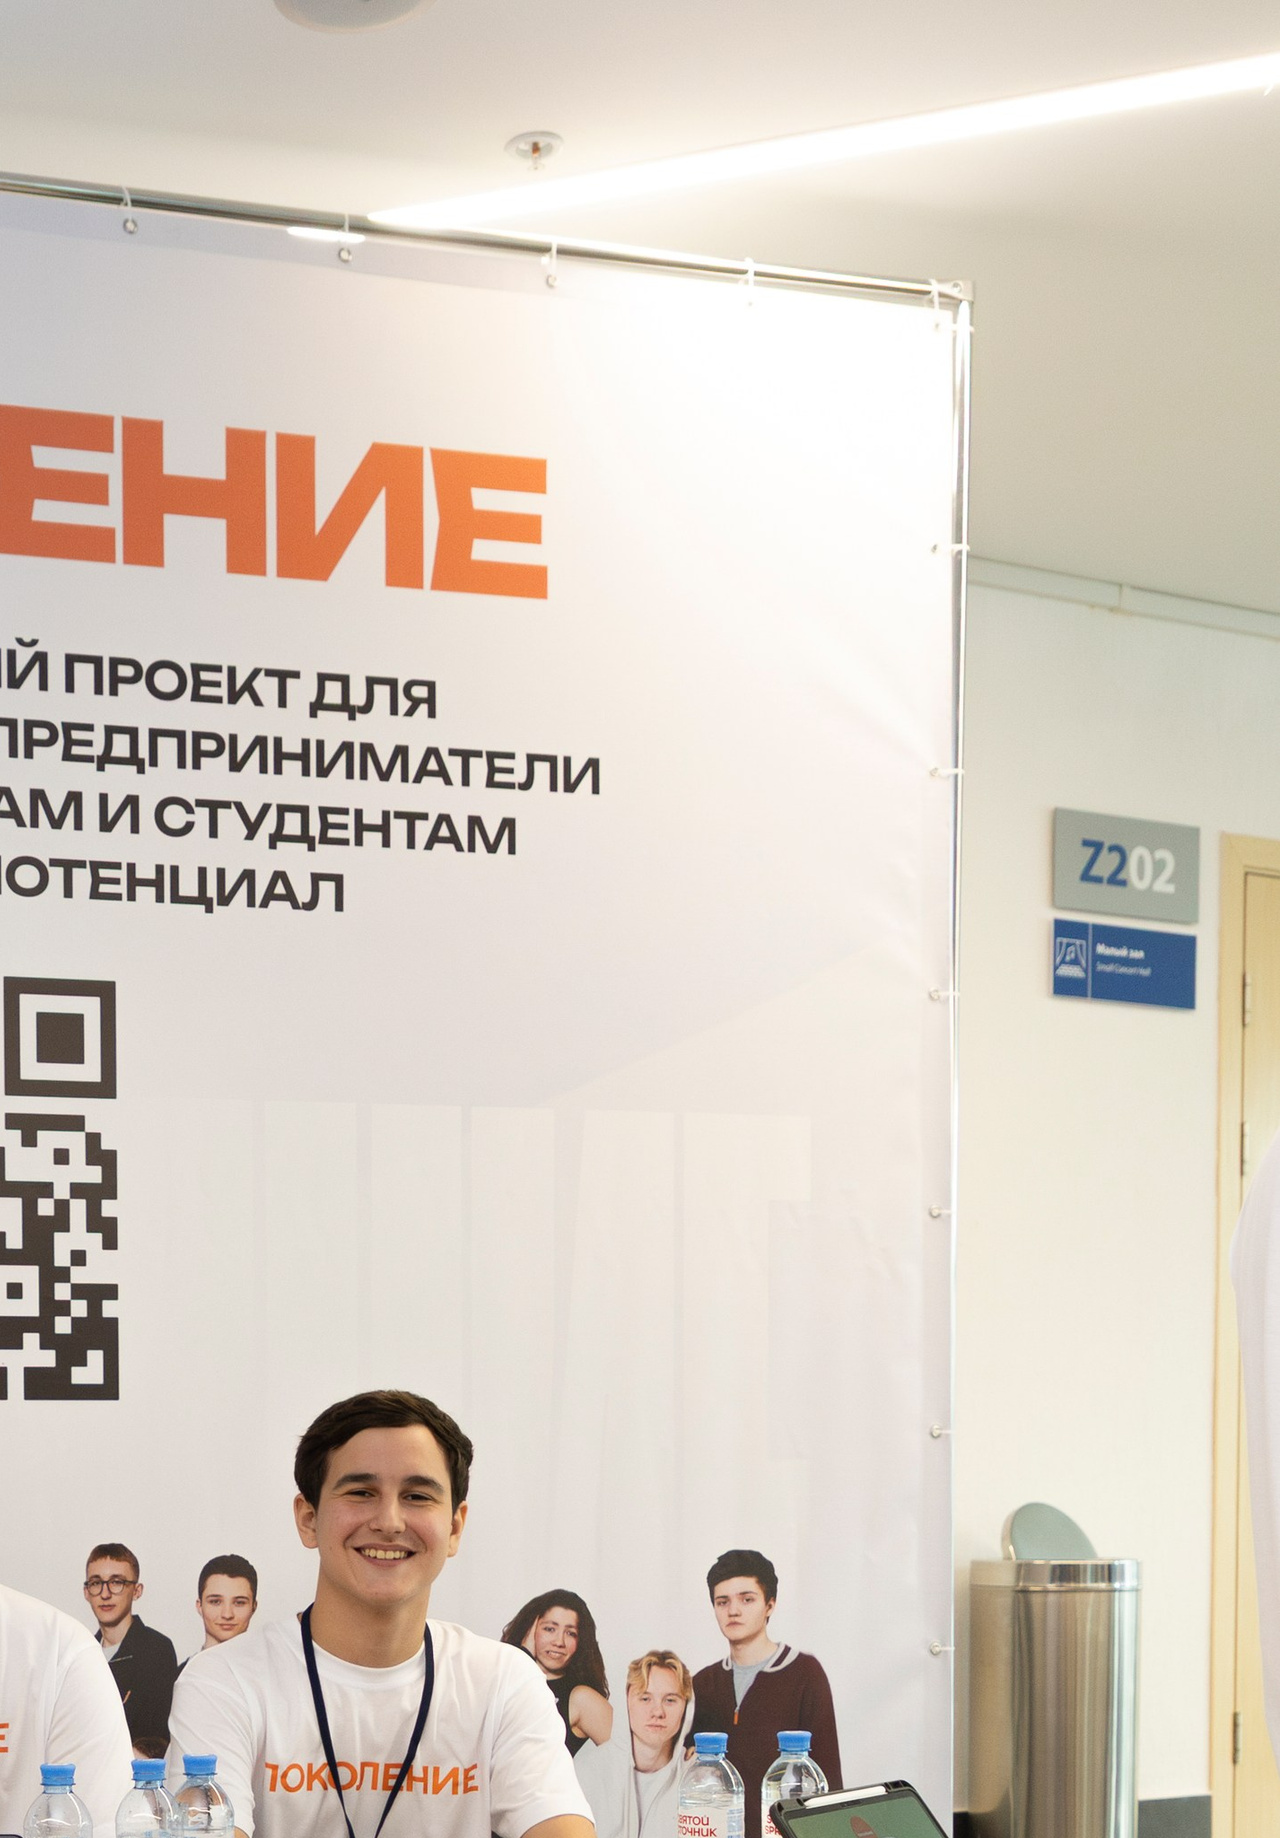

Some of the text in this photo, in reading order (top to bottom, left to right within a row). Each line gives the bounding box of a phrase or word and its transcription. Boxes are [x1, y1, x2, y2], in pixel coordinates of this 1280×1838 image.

[64, 652, 301, 709] ПРОЕКТ
[308, 671, 437, 720] ДЛЯ
[98, 792, 141, 835] И
[153, 795, 517, 856] СТУДЕНТАМ
[1079, 837, 1176, 894] Z202
[678, 1813, 710, 1826] ВЯТОЙ
[678, 1825, 718, 1838] ТОЧНИК
